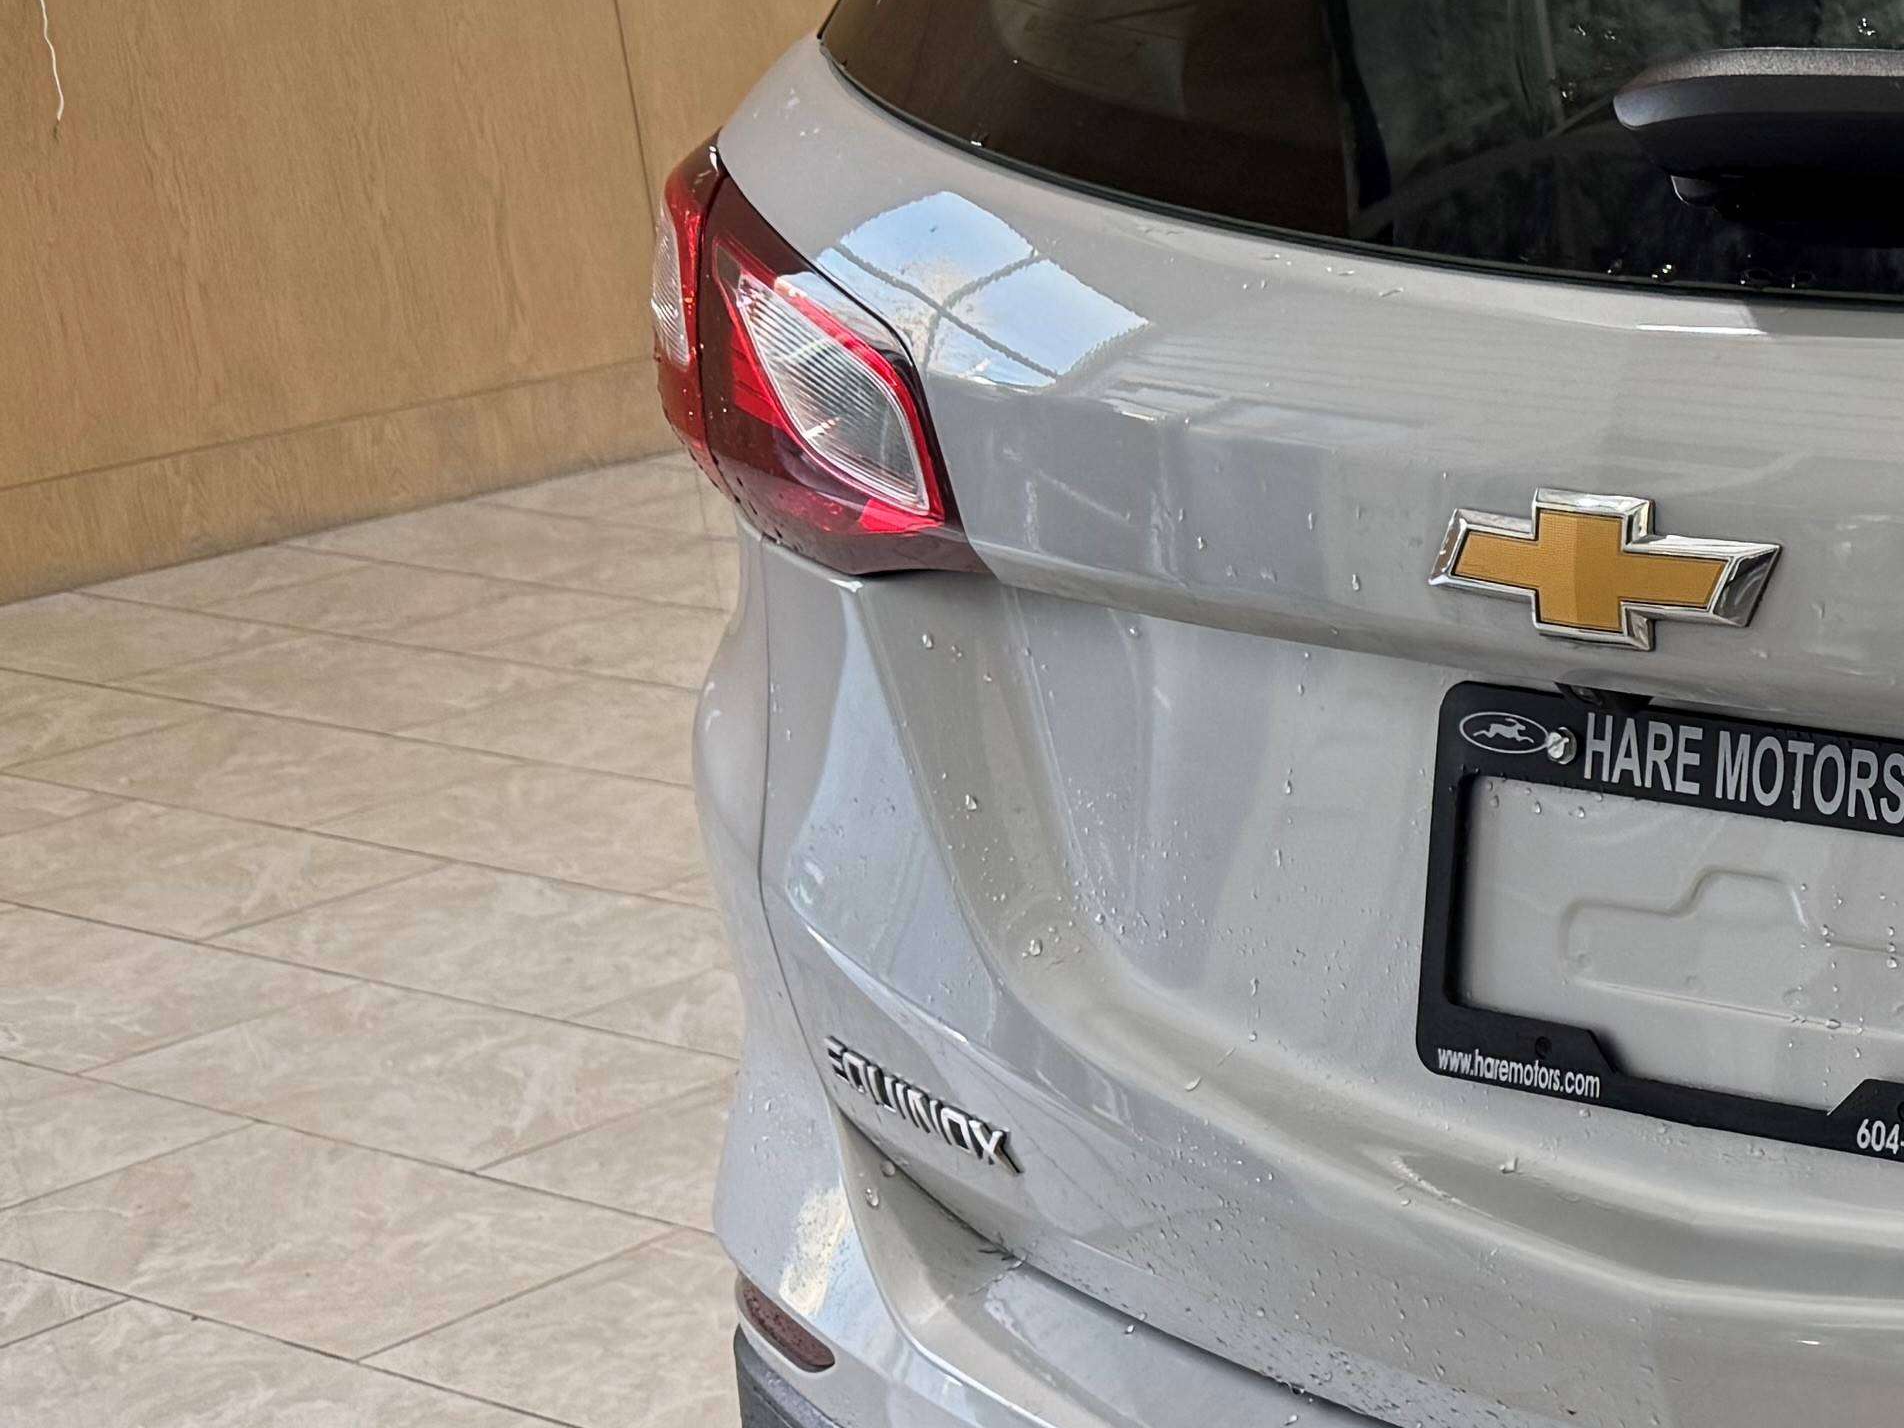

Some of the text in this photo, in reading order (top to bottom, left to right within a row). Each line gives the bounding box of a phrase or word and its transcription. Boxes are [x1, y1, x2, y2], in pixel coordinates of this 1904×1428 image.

[1584, 711, 1703, 795] HARE
[824, 1035, 1024, 1174] EQUINOX
[1437, 1048, 1600, 1099] www.haremotors.com
